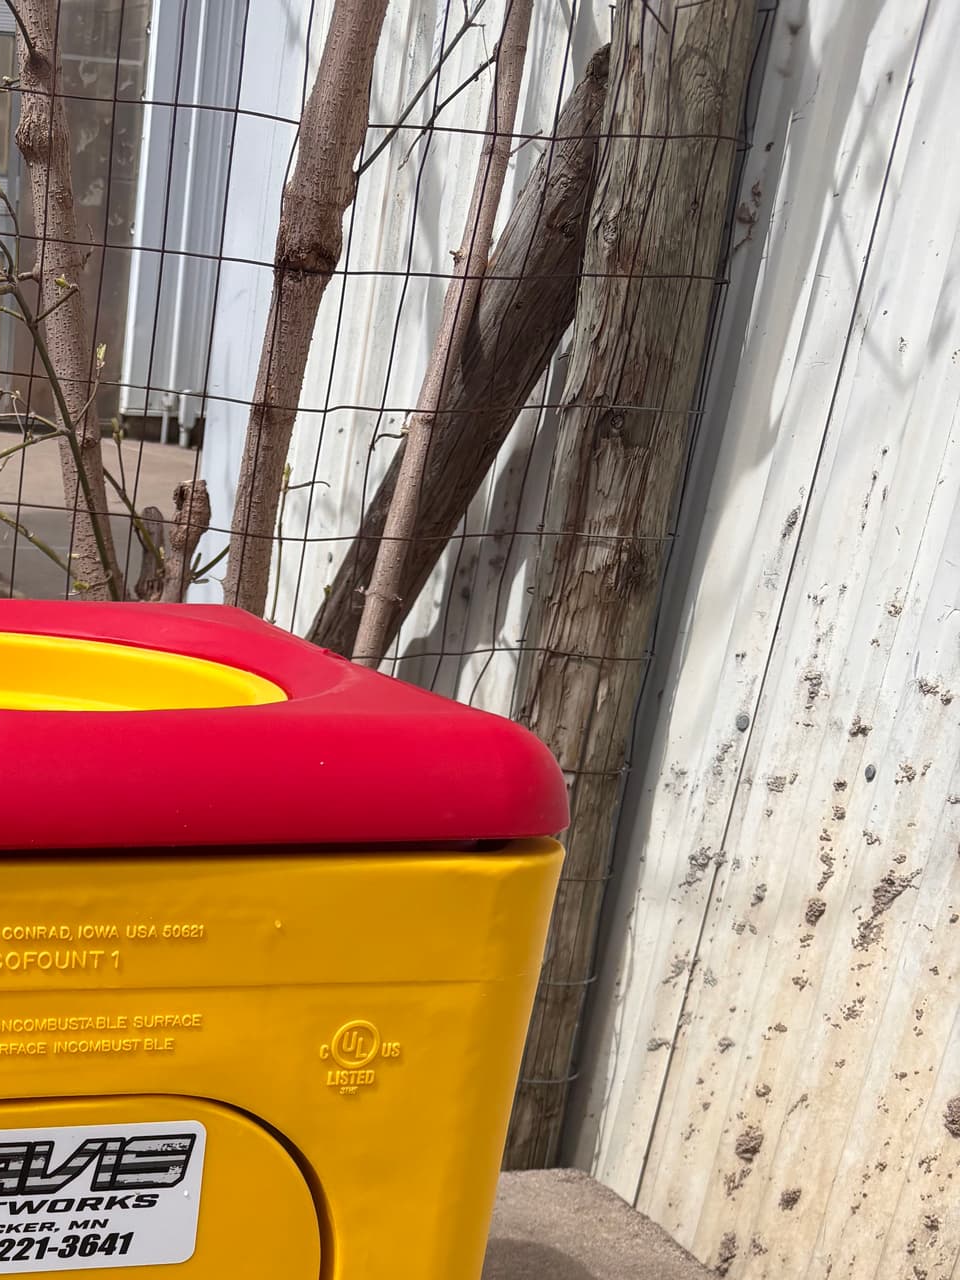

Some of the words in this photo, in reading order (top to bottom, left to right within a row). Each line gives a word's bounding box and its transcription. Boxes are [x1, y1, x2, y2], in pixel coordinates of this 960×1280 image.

[2, 925, 73, 941] CONRAD,
[78, 924, 120, 940] IOWA
[126, 924, 158, 939] USA
[162, 924, 205, 938] 50621
[111, 949, 121, 969] 1
[133, 1013, 203, 1029] SURFACE
[342, 1031, 368, 1059] UL
[381, 1041, 401, 1058] US
[326, 1069, 375, 1086] LISTED
[68, 1218, 110, 1231] MN
